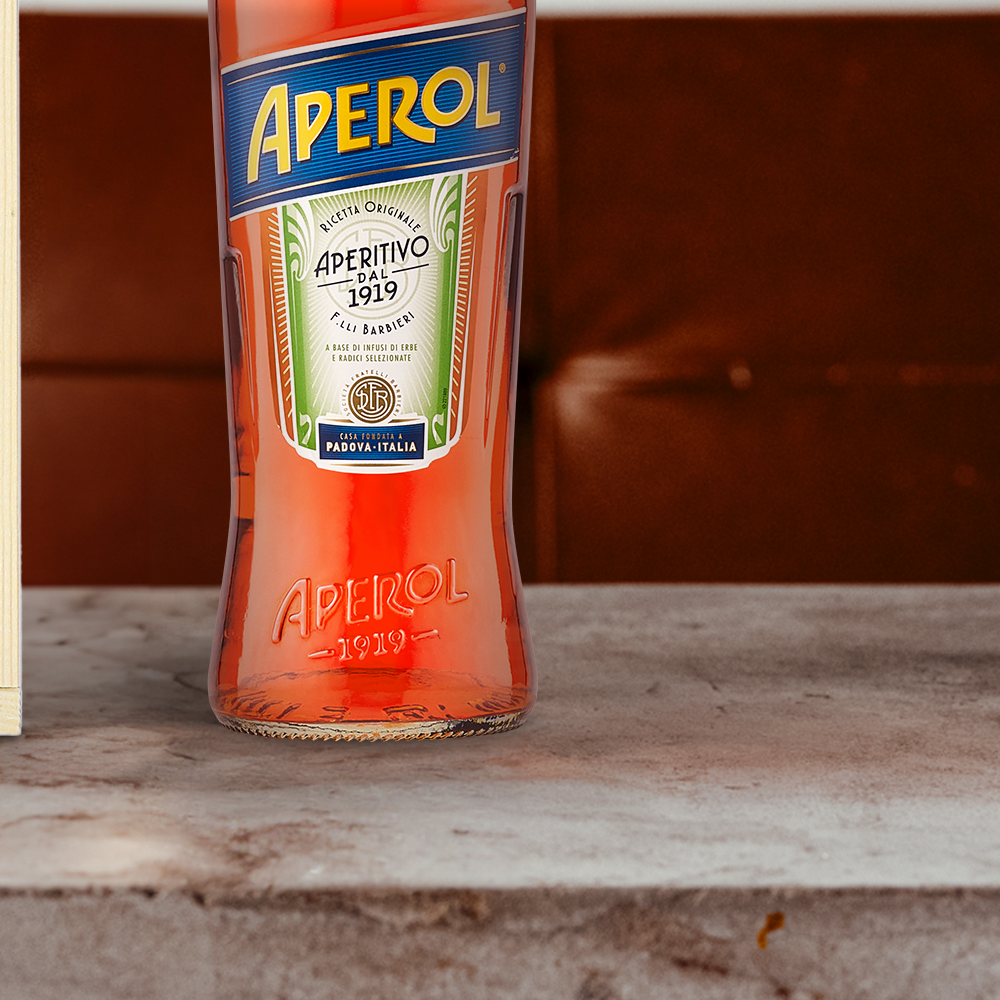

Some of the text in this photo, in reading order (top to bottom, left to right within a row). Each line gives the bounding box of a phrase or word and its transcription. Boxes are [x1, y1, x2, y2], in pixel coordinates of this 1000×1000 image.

[246, 60, 501, 185] APEROL
[319, 201, 422, 233] RICETTA ORIGINALE
[314, 235, 430, 278] APERITIVO
[357, 269, 388, 284] DAL
[348, 281, 398, 308] 1919
[330, 311, 415, 335] F.LLI BARBIERI
[325, 343, 418, 352] A BASE DI INFUSI DI ERBE
[339, 354, 363, 362] RADICI
[365, 354, 412, 362] SELEZIONATE
[271, 557, 470, 644] APEROL
[337, 629, 407, 661] 1919
